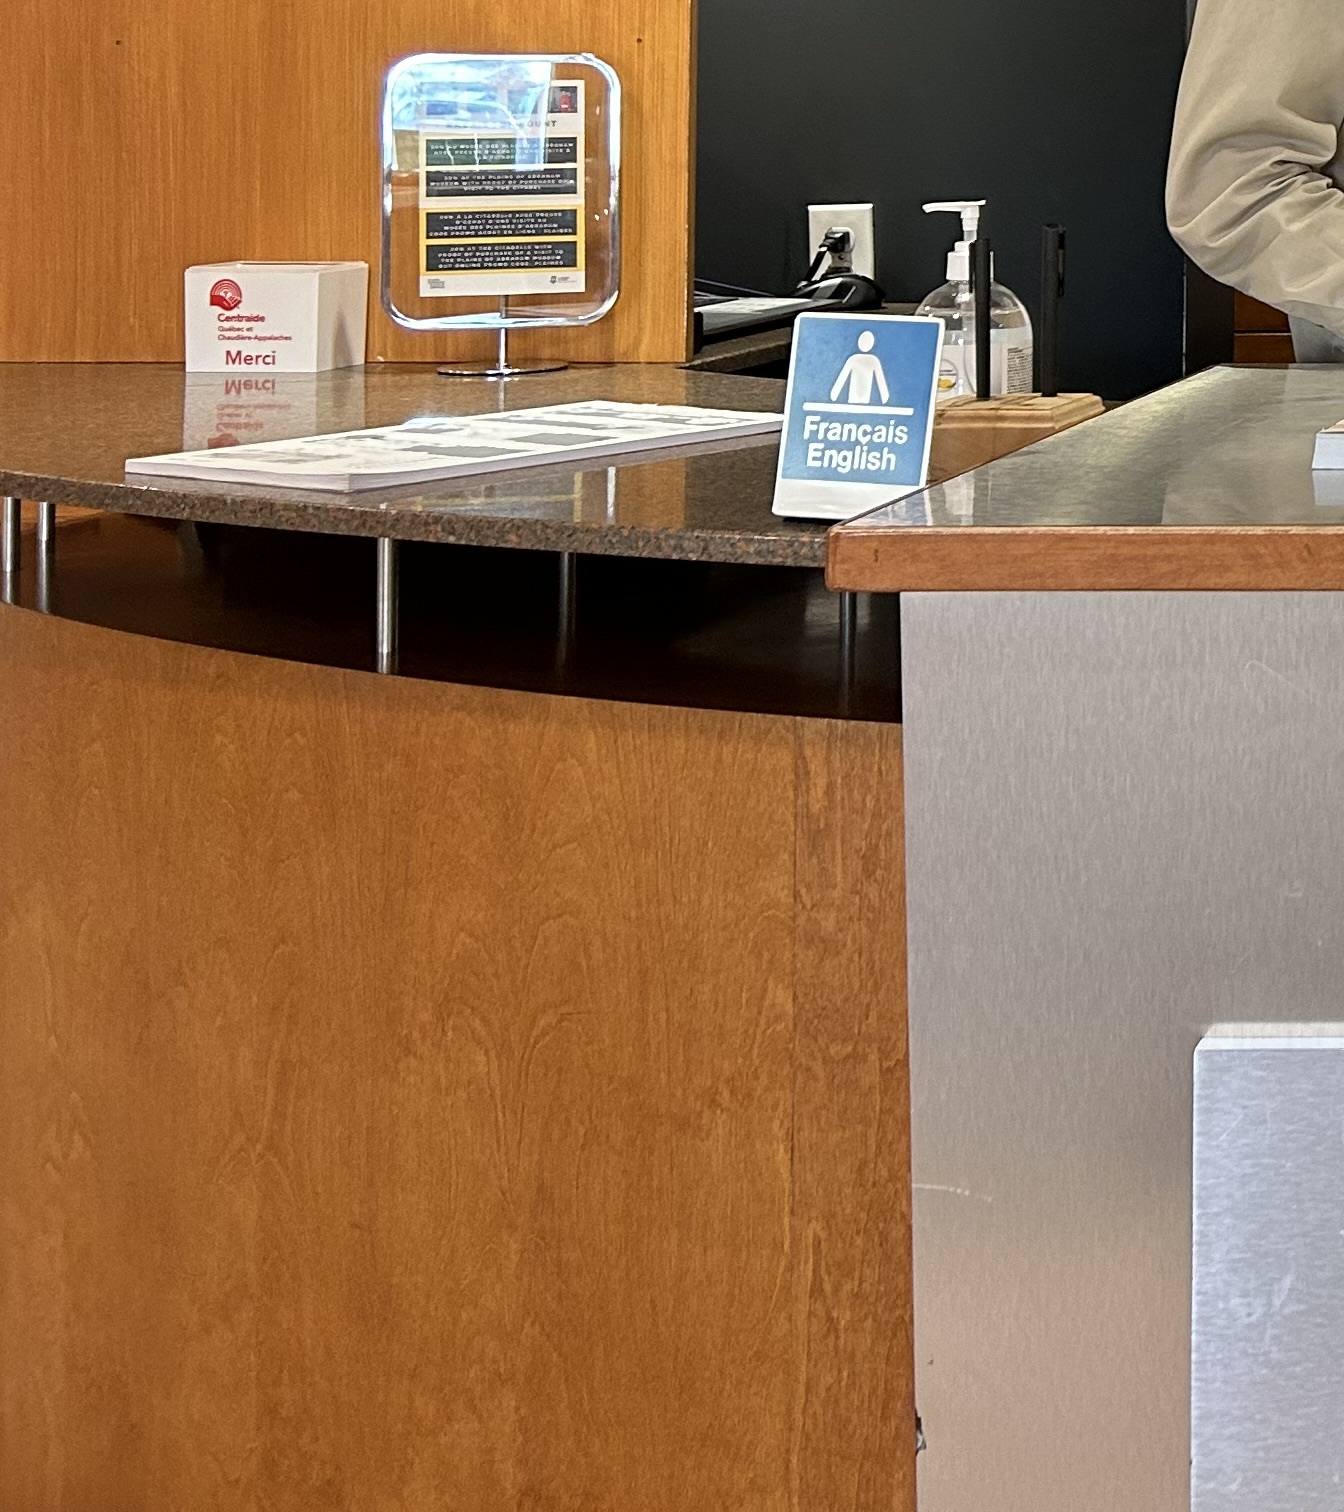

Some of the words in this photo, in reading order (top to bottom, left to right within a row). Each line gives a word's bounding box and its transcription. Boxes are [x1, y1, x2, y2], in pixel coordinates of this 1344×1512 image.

[217, 313, 266, 322] Centraide
[225, 350, 277, 365] Merci
[803, 415, 909, 445] Français
[806, 442, 897, 473] English
